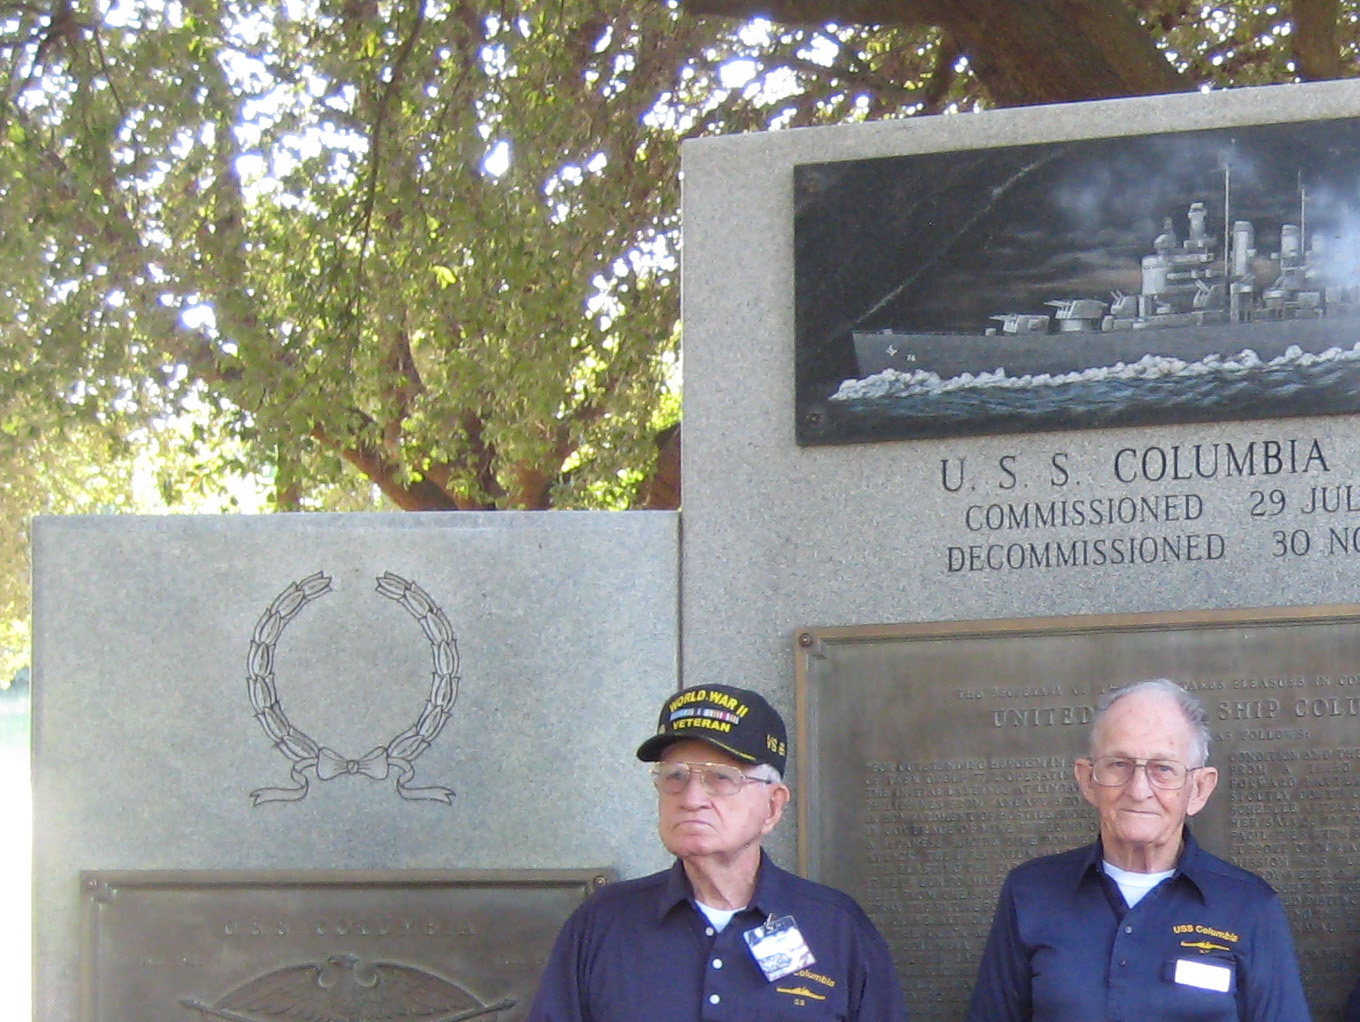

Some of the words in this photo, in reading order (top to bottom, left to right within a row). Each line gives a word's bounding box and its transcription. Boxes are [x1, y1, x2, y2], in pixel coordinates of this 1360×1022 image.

[1113, 438, 1331, 484] COLUMBIA
[965, 493, 1204, 532] COMMISSIONED
[1249, 489, 1286, 517] 29
[948, 532, 1226, 573] DECOMMISSIONED
[1272, 529, 1311, 558] 30
[668, 689, 707, 713] WORLD
[709, 690, 738, 711] WAR
[736, 704, 749, 718] II
[1218, 698, 1282, 721] SHIP
[672, 718, 732, 733] VETERAN
[991, 706, 1095, 729] UNITED
[1172, 925, 1194, 935] USS
[1195, 926, 1239, 943] Columbia
